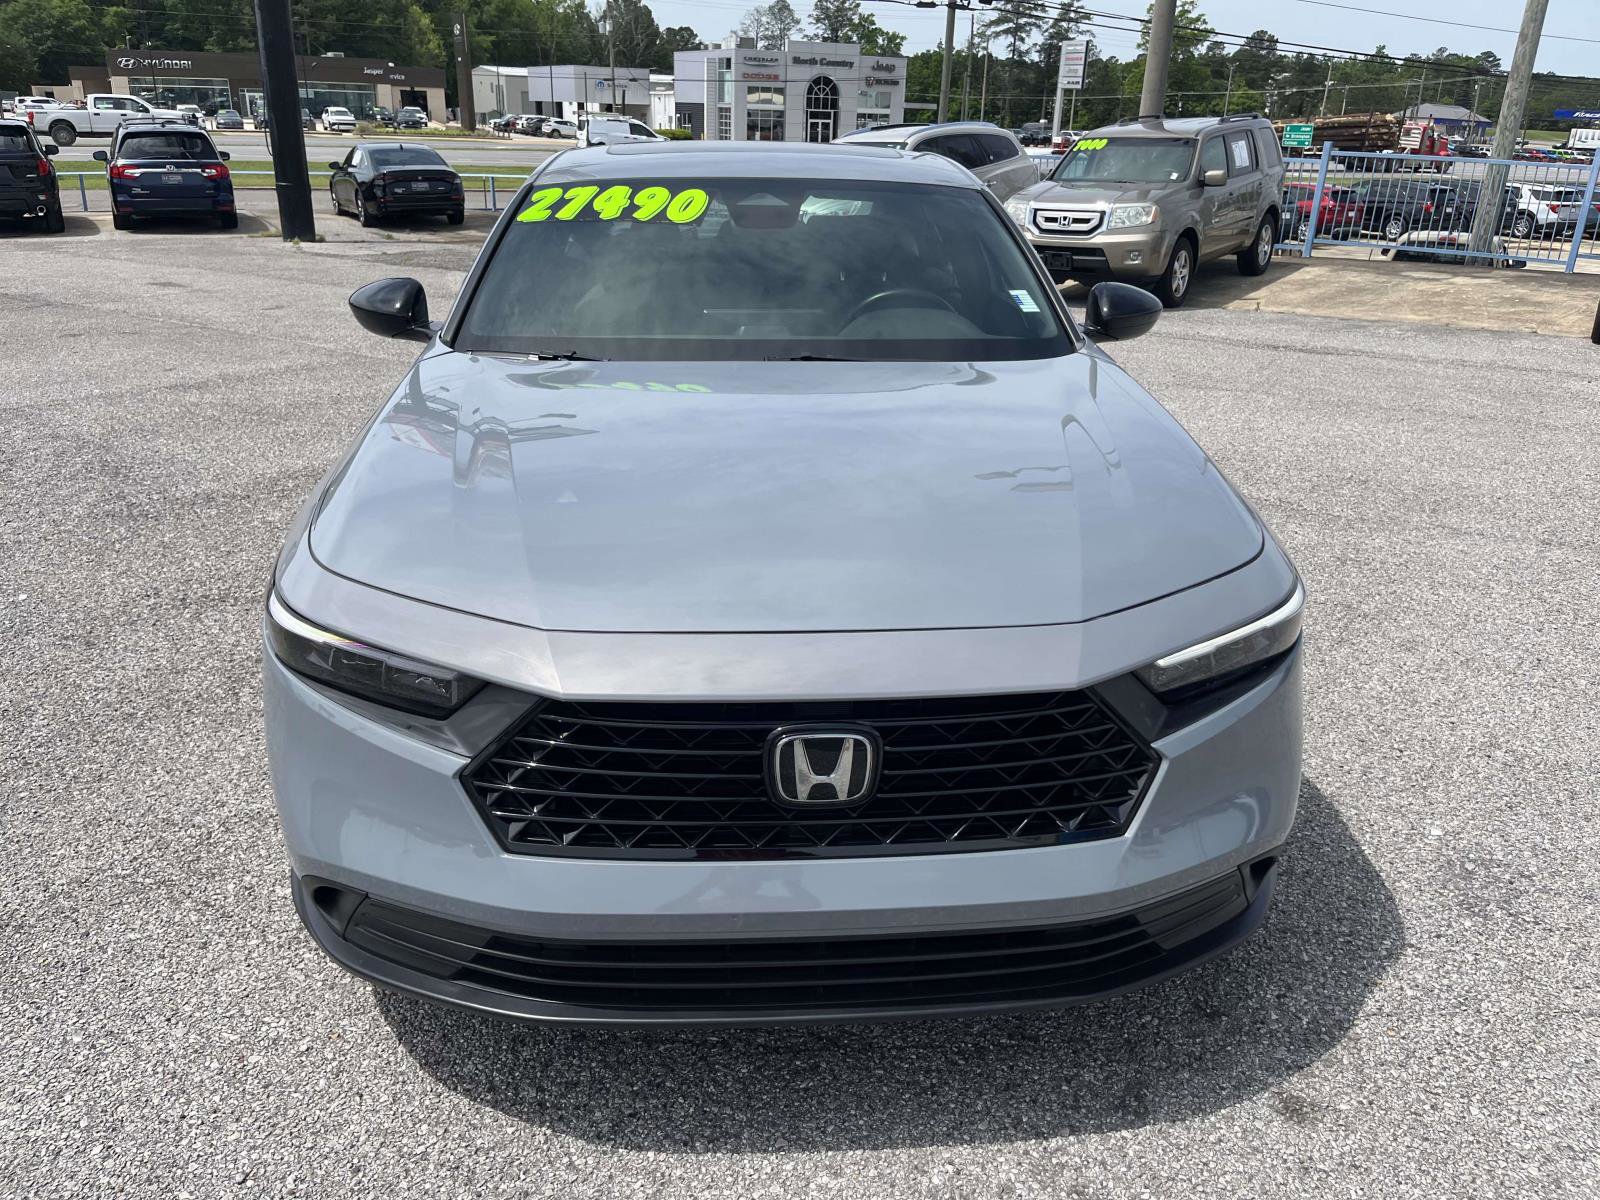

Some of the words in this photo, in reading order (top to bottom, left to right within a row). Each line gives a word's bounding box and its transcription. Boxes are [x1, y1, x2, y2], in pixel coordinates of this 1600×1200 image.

[139, 58, 192, 69] HYUNDAI
[792, 56, 818, 66] North
[819, 57, 855, 70] Country
[871, 60, 896, 74] Jeep
[516, 185, 709, 224] 27490
